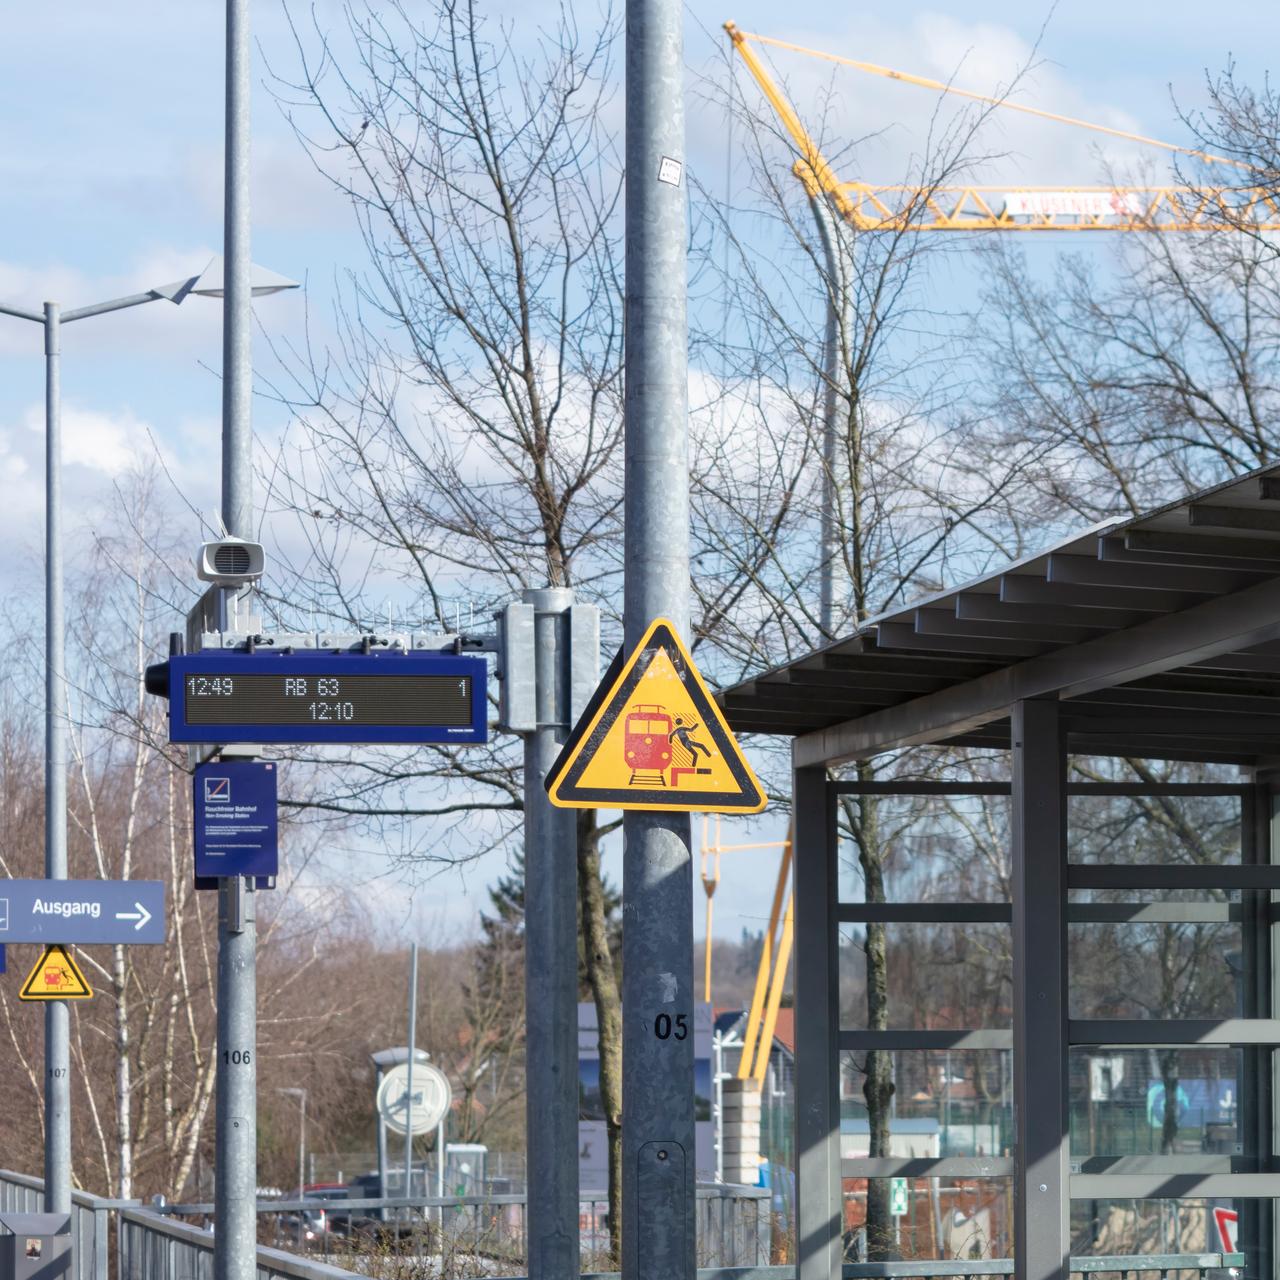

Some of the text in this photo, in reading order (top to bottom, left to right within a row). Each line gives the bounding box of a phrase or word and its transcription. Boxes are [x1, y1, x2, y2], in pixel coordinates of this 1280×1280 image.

[188, 677, 466, 697] 12:49 RB 63 1
[309, 702, 354, 720] 12:10
[32, 898, 101, 918] Ausgang
[223, 1050, 251, 1065] 106
[49, 1068, 67, 1078] 107
